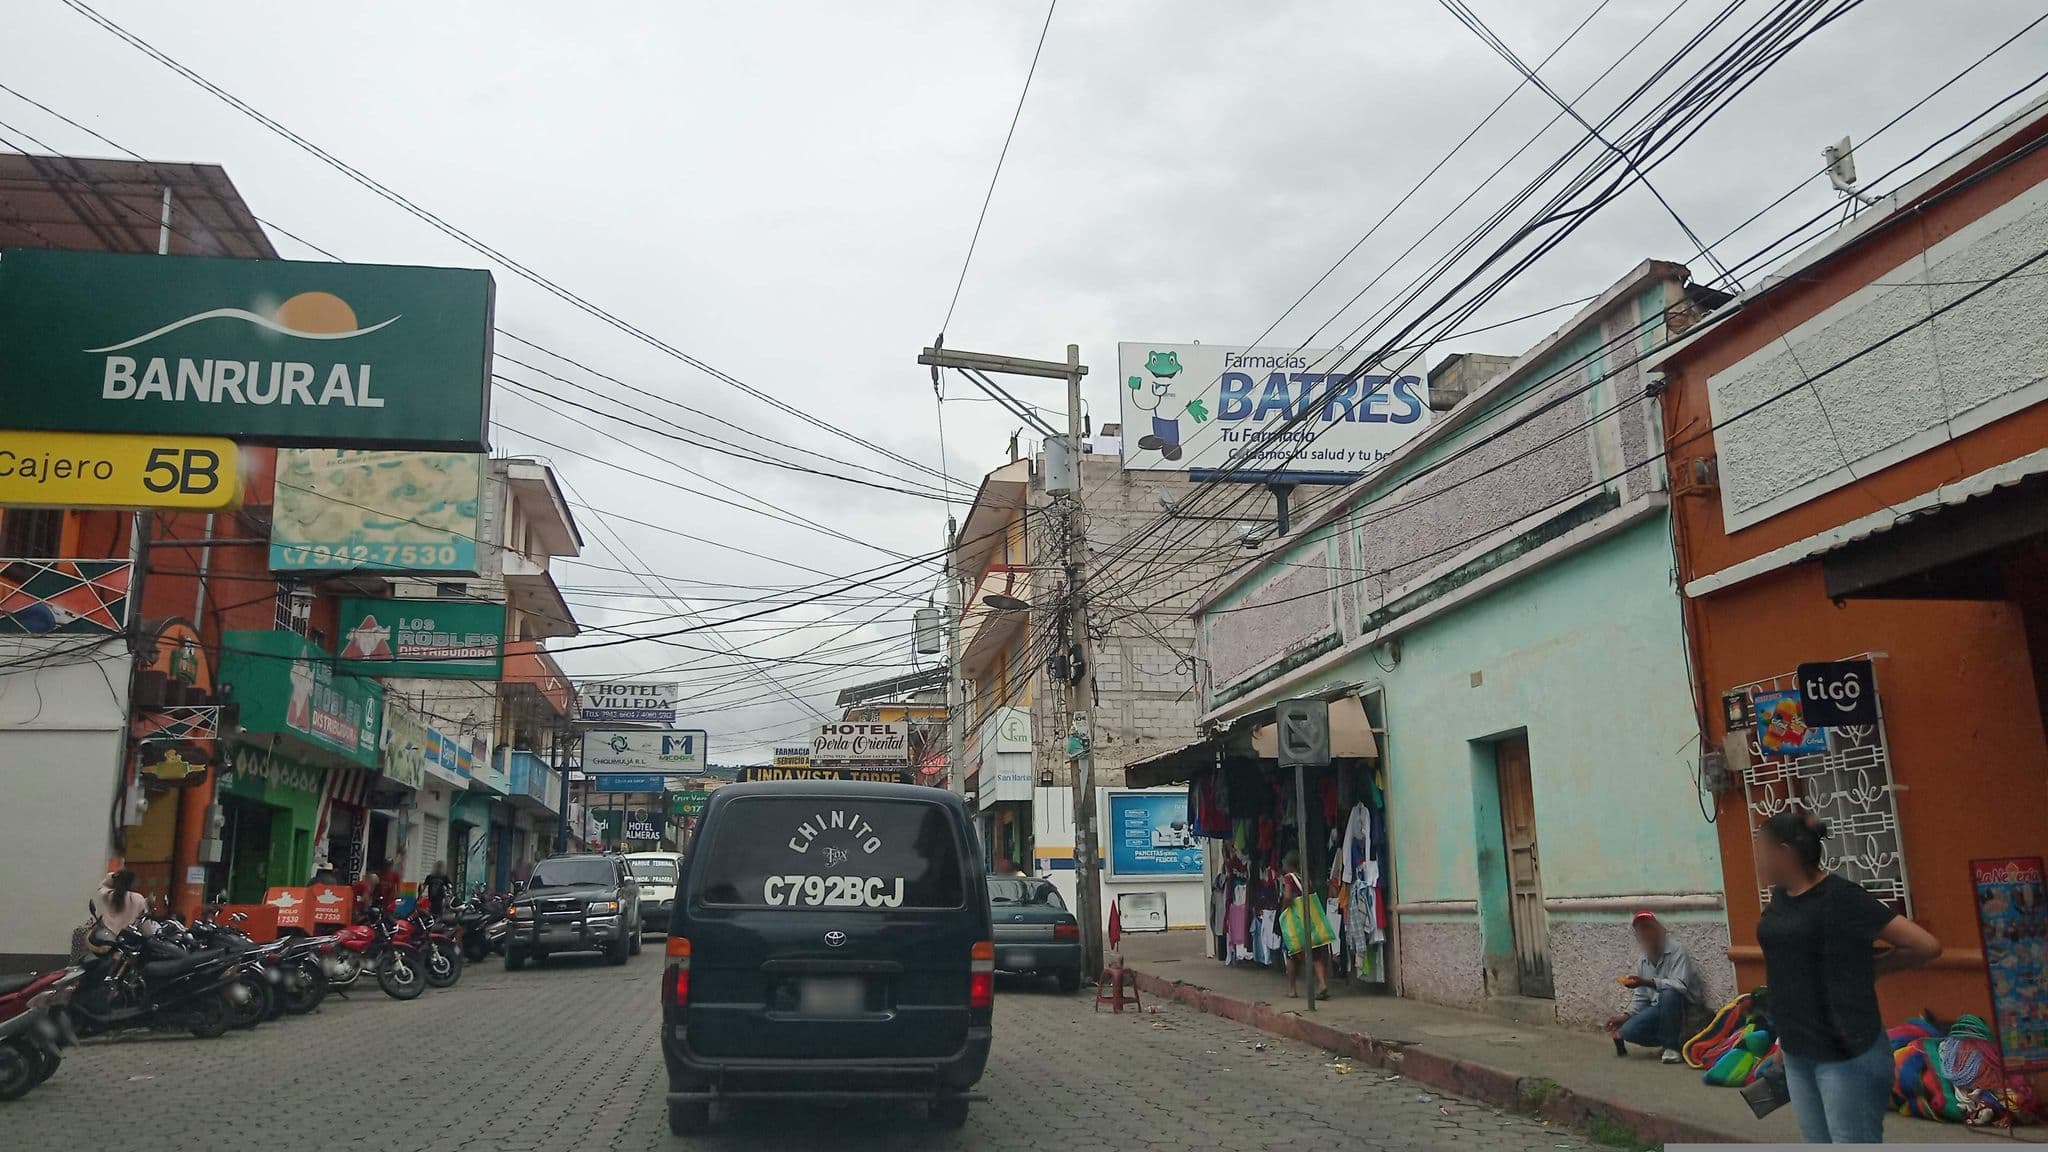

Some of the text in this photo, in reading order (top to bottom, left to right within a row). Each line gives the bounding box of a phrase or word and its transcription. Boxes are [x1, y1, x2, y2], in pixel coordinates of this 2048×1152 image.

[1224, 352, 1306, 369] Farmacias
[103, 355, 384, 408] BANRURAL
[1215, 371, 1422, 425] BATRES
[1221, 428, 1316, 443] Tu Farmacia
[1310, 448, 1344, 461] salud
[1348, 452, 1355, 465] y
[1358, 450, 1372, 461] tu
[0, 448, 219, 494] Cajero 5B
[294, 545, 457, 566] 7942-7530
[399, 617, 436, 631] LOS
[397, 630, 499, 648] ROBLES
[399, 645, 495, 659] DISTRIBUIDORA
[599, 684, 662, 696] HOTEL
[589, 695, 669, 709] VILLEDA
[821, 724, 898, 736] HOTEL
[814, 734, 905, 755] Perla Oriental
[776, 757, 803, 767] SERVICIO
[625, 830, 661, 840] ALMERAS
[628, 821, 654, 832] HOTEL
[788, 810, 882, 854] CHINITO
[763, 874, 905, 908] C792BCJ
